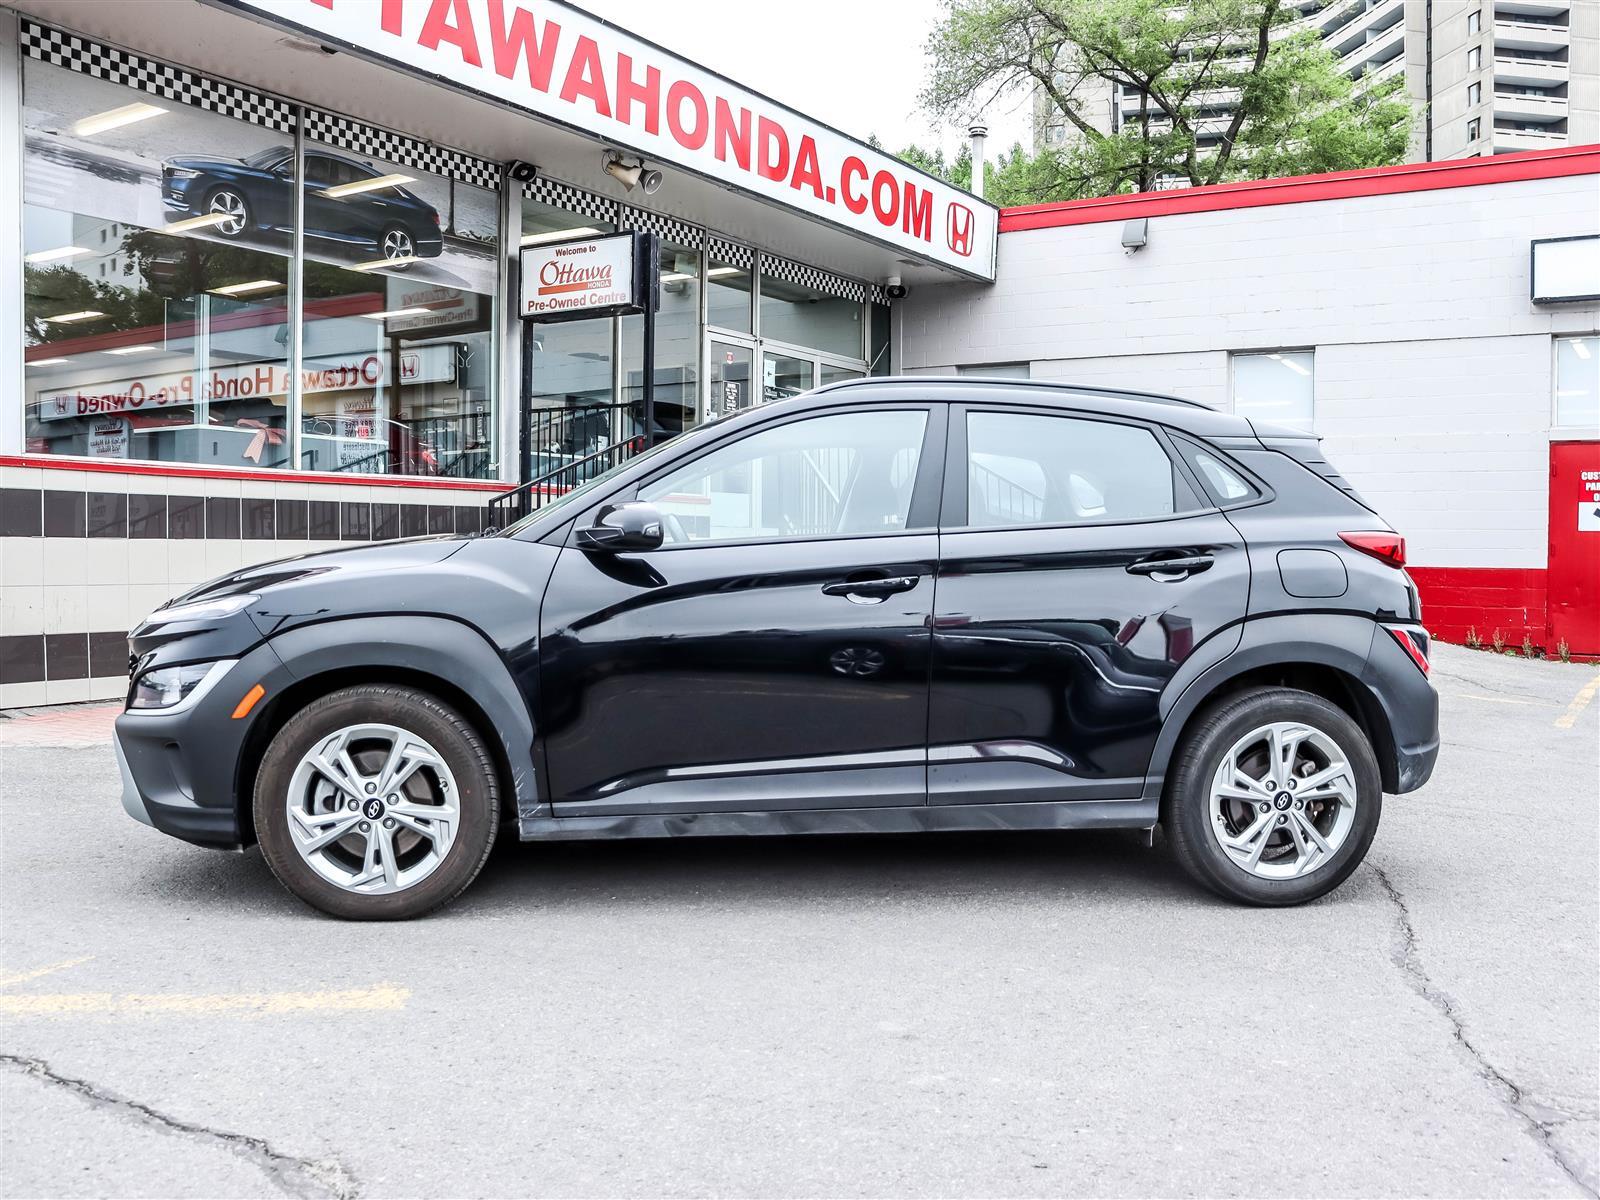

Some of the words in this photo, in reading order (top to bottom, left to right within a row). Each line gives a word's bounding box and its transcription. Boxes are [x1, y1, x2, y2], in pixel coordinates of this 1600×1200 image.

[311, 0, 933, 242] AWAHONDA.COM
[555, 247, 588, 257] Welcome
[589, 245, 597, 253] to
[540, 260, 613, 286] Ottawa
[587, 281, 610, 289] HONDA
[528, 295, 586, 312] Pre-Owned
[589, 291, 627, 305] Centre
[1593, 493, 1600, 502] O
